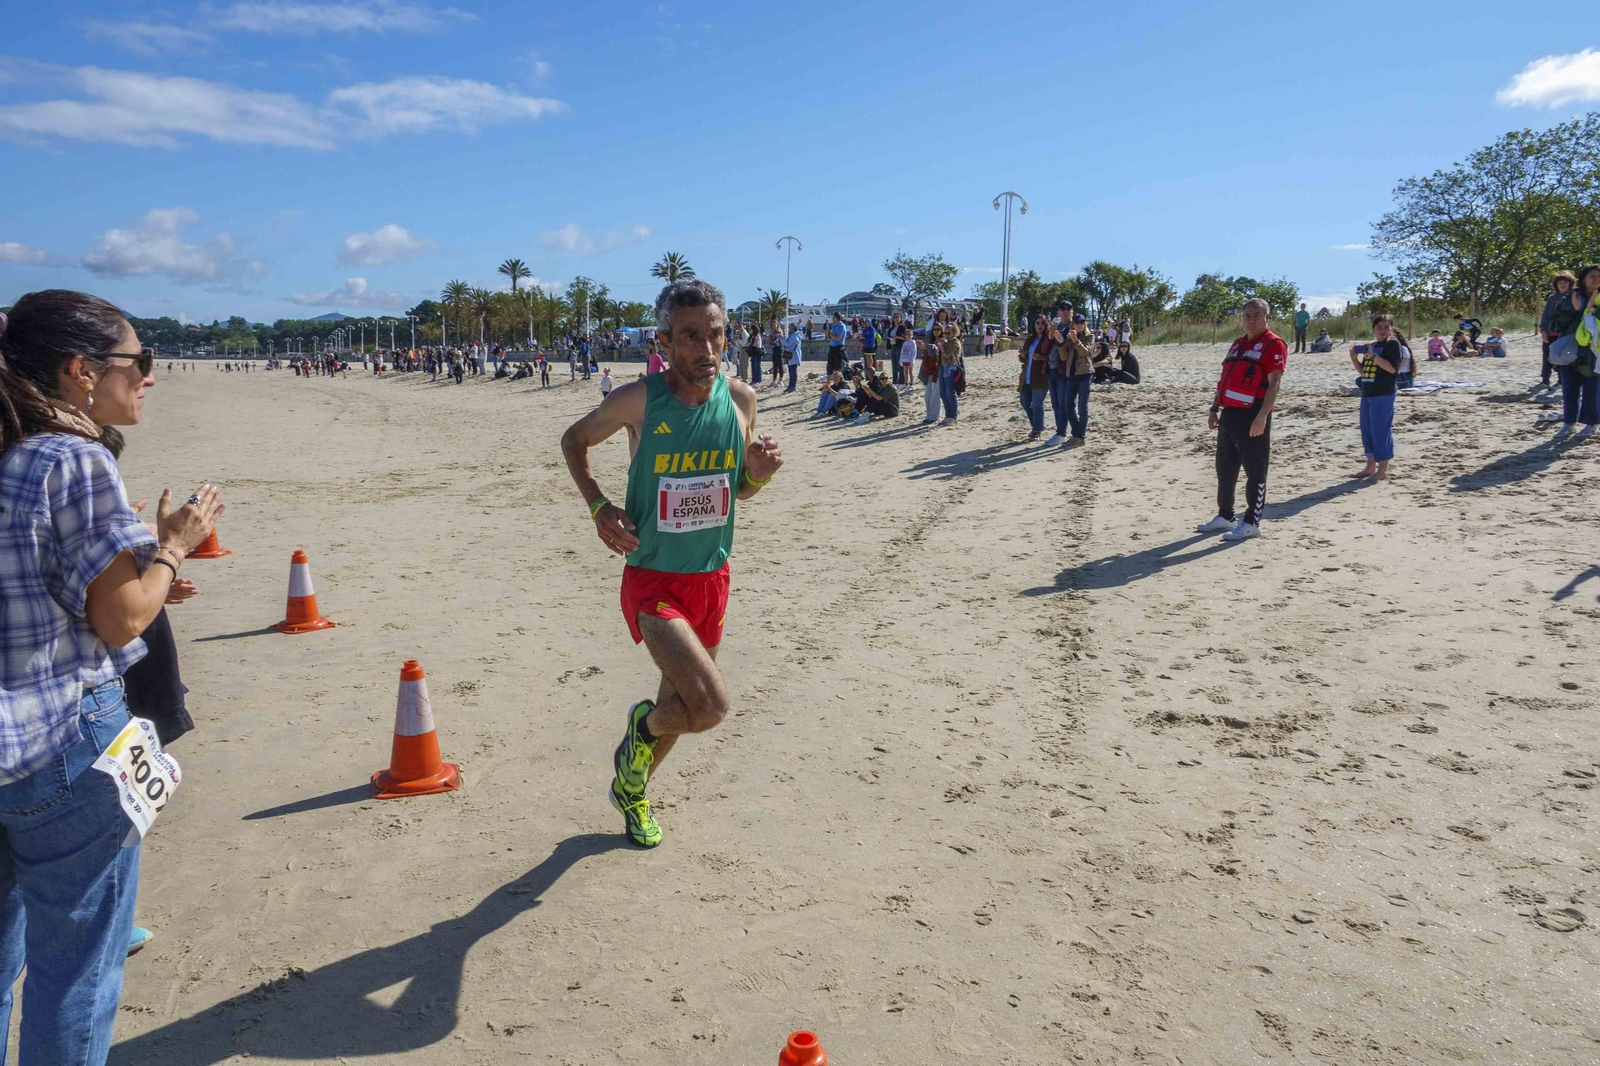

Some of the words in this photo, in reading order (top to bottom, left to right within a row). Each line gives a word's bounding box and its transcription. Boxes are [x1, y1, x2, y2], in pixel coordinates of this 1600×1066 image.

[654, 450, 737, 474] BIKILA
[679, 493, 712, 507] JESÚS
[673, 504, 716, 518] ESPAÑA
